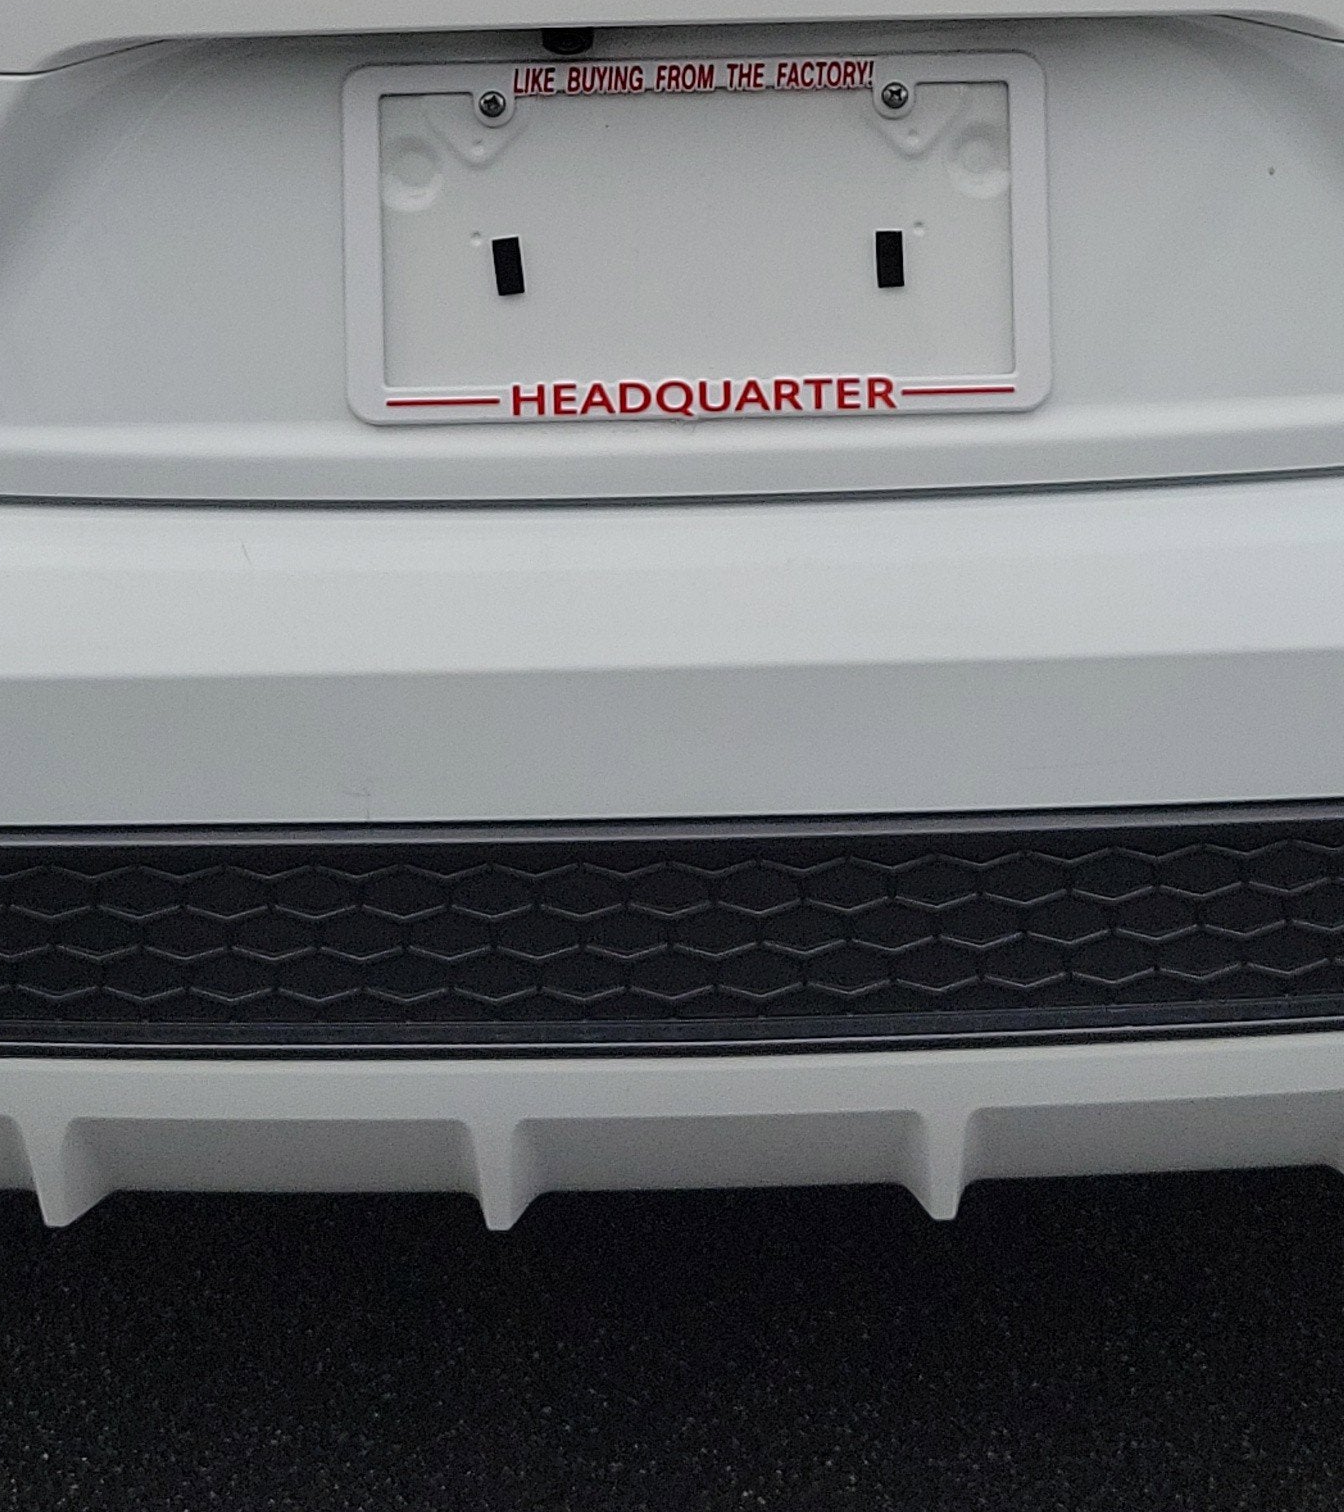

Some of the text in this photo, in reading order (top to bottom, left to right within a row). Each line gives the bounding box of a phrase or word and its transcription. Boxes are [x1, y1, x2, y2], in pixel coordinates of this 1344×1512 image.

[513, 61, 874, 94] LIKE BUYING FROM THE FACTORY!
[512, 377, 897, 416] HEADQUARTER
